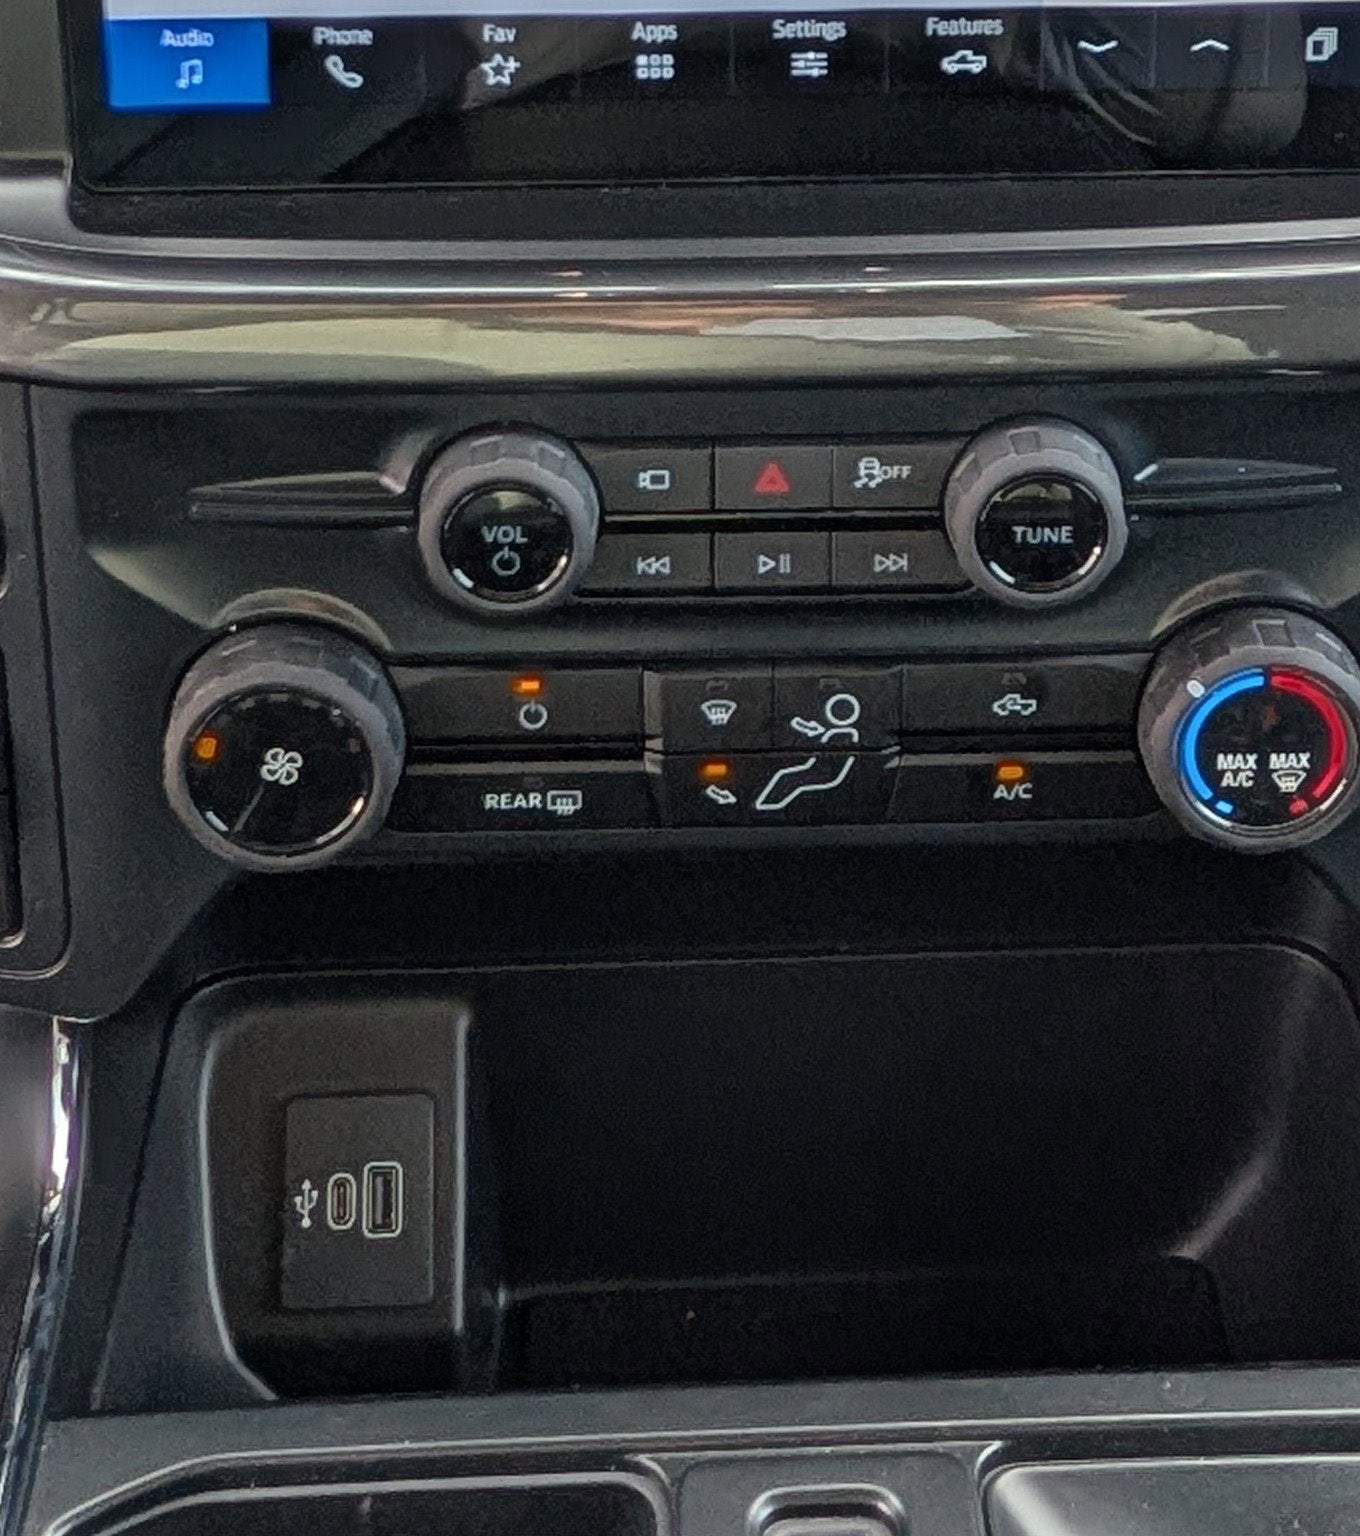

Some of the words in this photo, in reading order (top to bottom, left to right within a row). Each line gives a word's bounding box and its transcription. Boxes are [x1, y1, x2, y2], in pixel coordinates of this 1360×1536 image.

[482, 23, 516, 44] Fav
[632, 20, 678, 44] Apps
[771, 18, 846, 41] Settings
[926, 16, 1003, 38] Features
[160, 28, 214, 48] Audio
[314, 26, 373, 47] Phone
[881, 465, 912, 479] OFF
[481, 525, 528, 543] VOL
[1012, 526, 1074, 544] TUNE
[1217, 753, 1258, 770] MAX
[1269, 752, 1311, 769] MAX
[1221, 771, 1255, 787] A/C
[993, 783, 1033, 801] A/C
[484, 792, 542, 811] REAR
